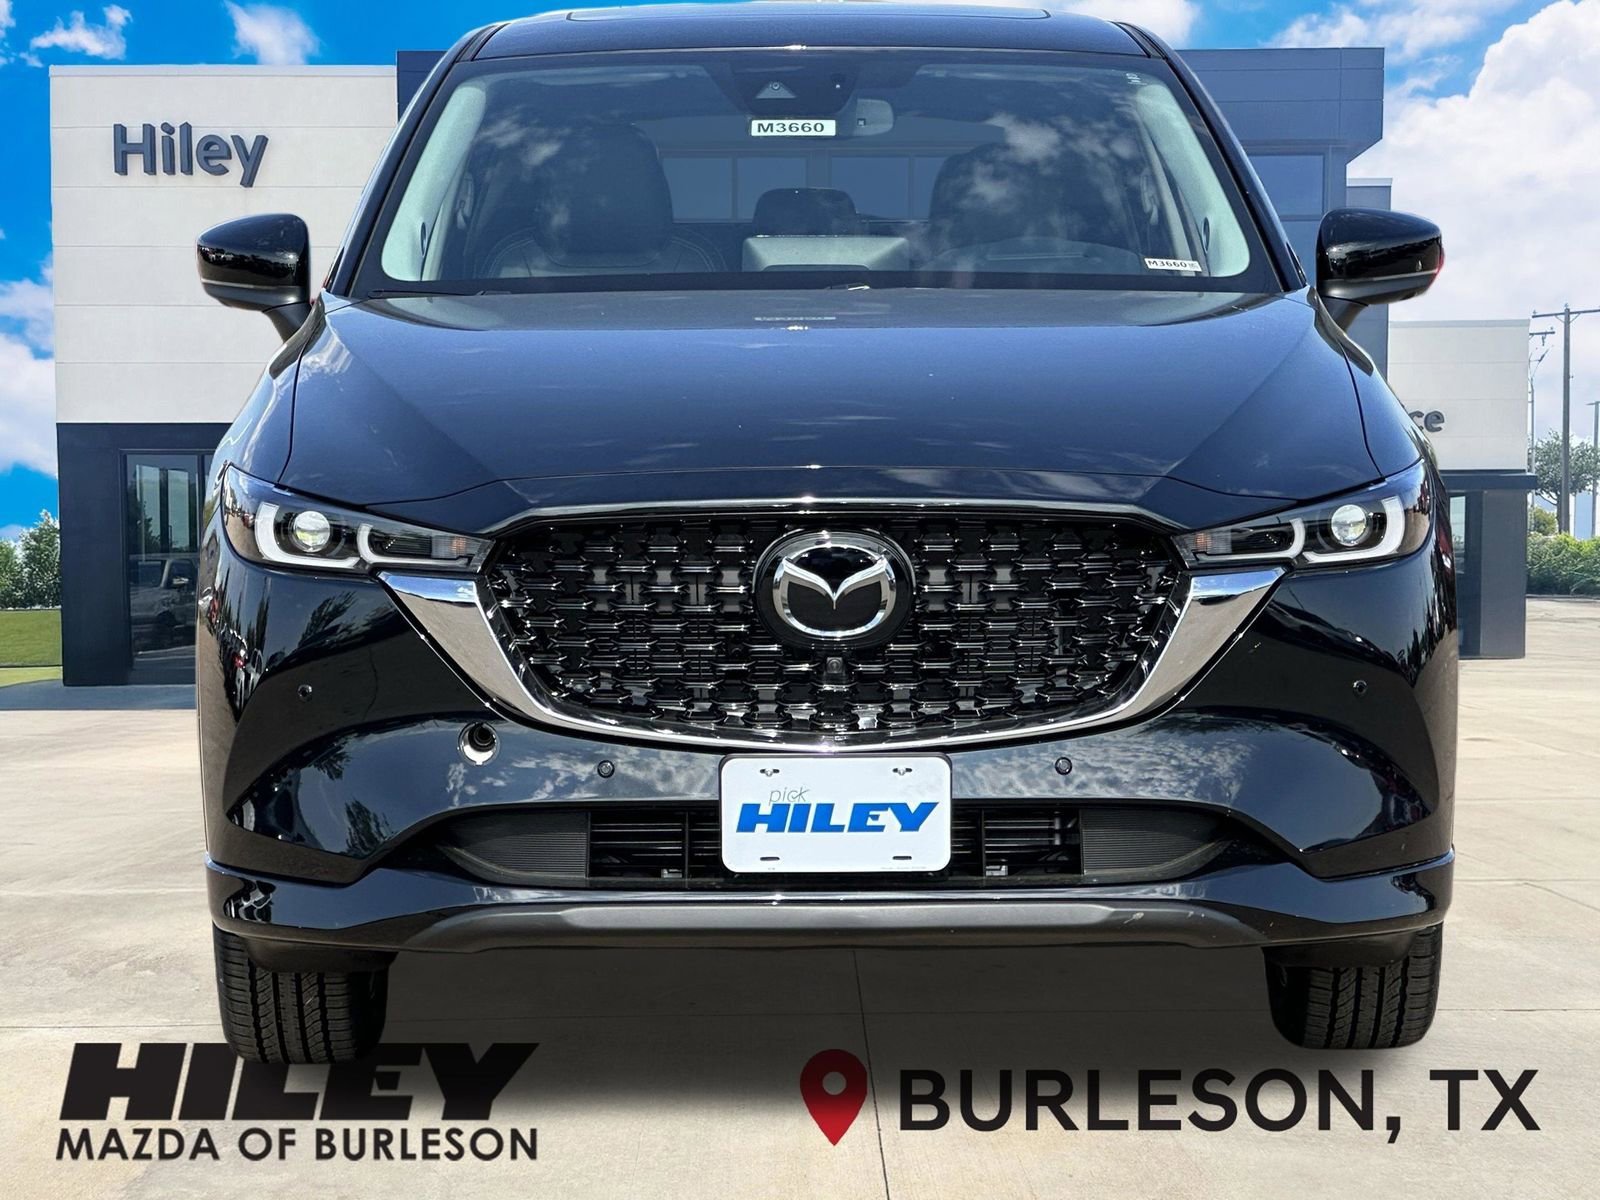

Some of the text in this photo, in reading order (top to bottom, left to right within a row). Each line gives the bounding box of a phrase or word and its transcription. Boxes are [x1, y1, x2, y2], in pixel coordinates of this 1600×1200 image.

[756, 122, 825, 133] M3660
[113, 122, 268, 188] Hiley
[1147, 259, 1187, 268] M3660
[768, 786, 811, 806] pick
[735, 801, 939, 833] HILEY
